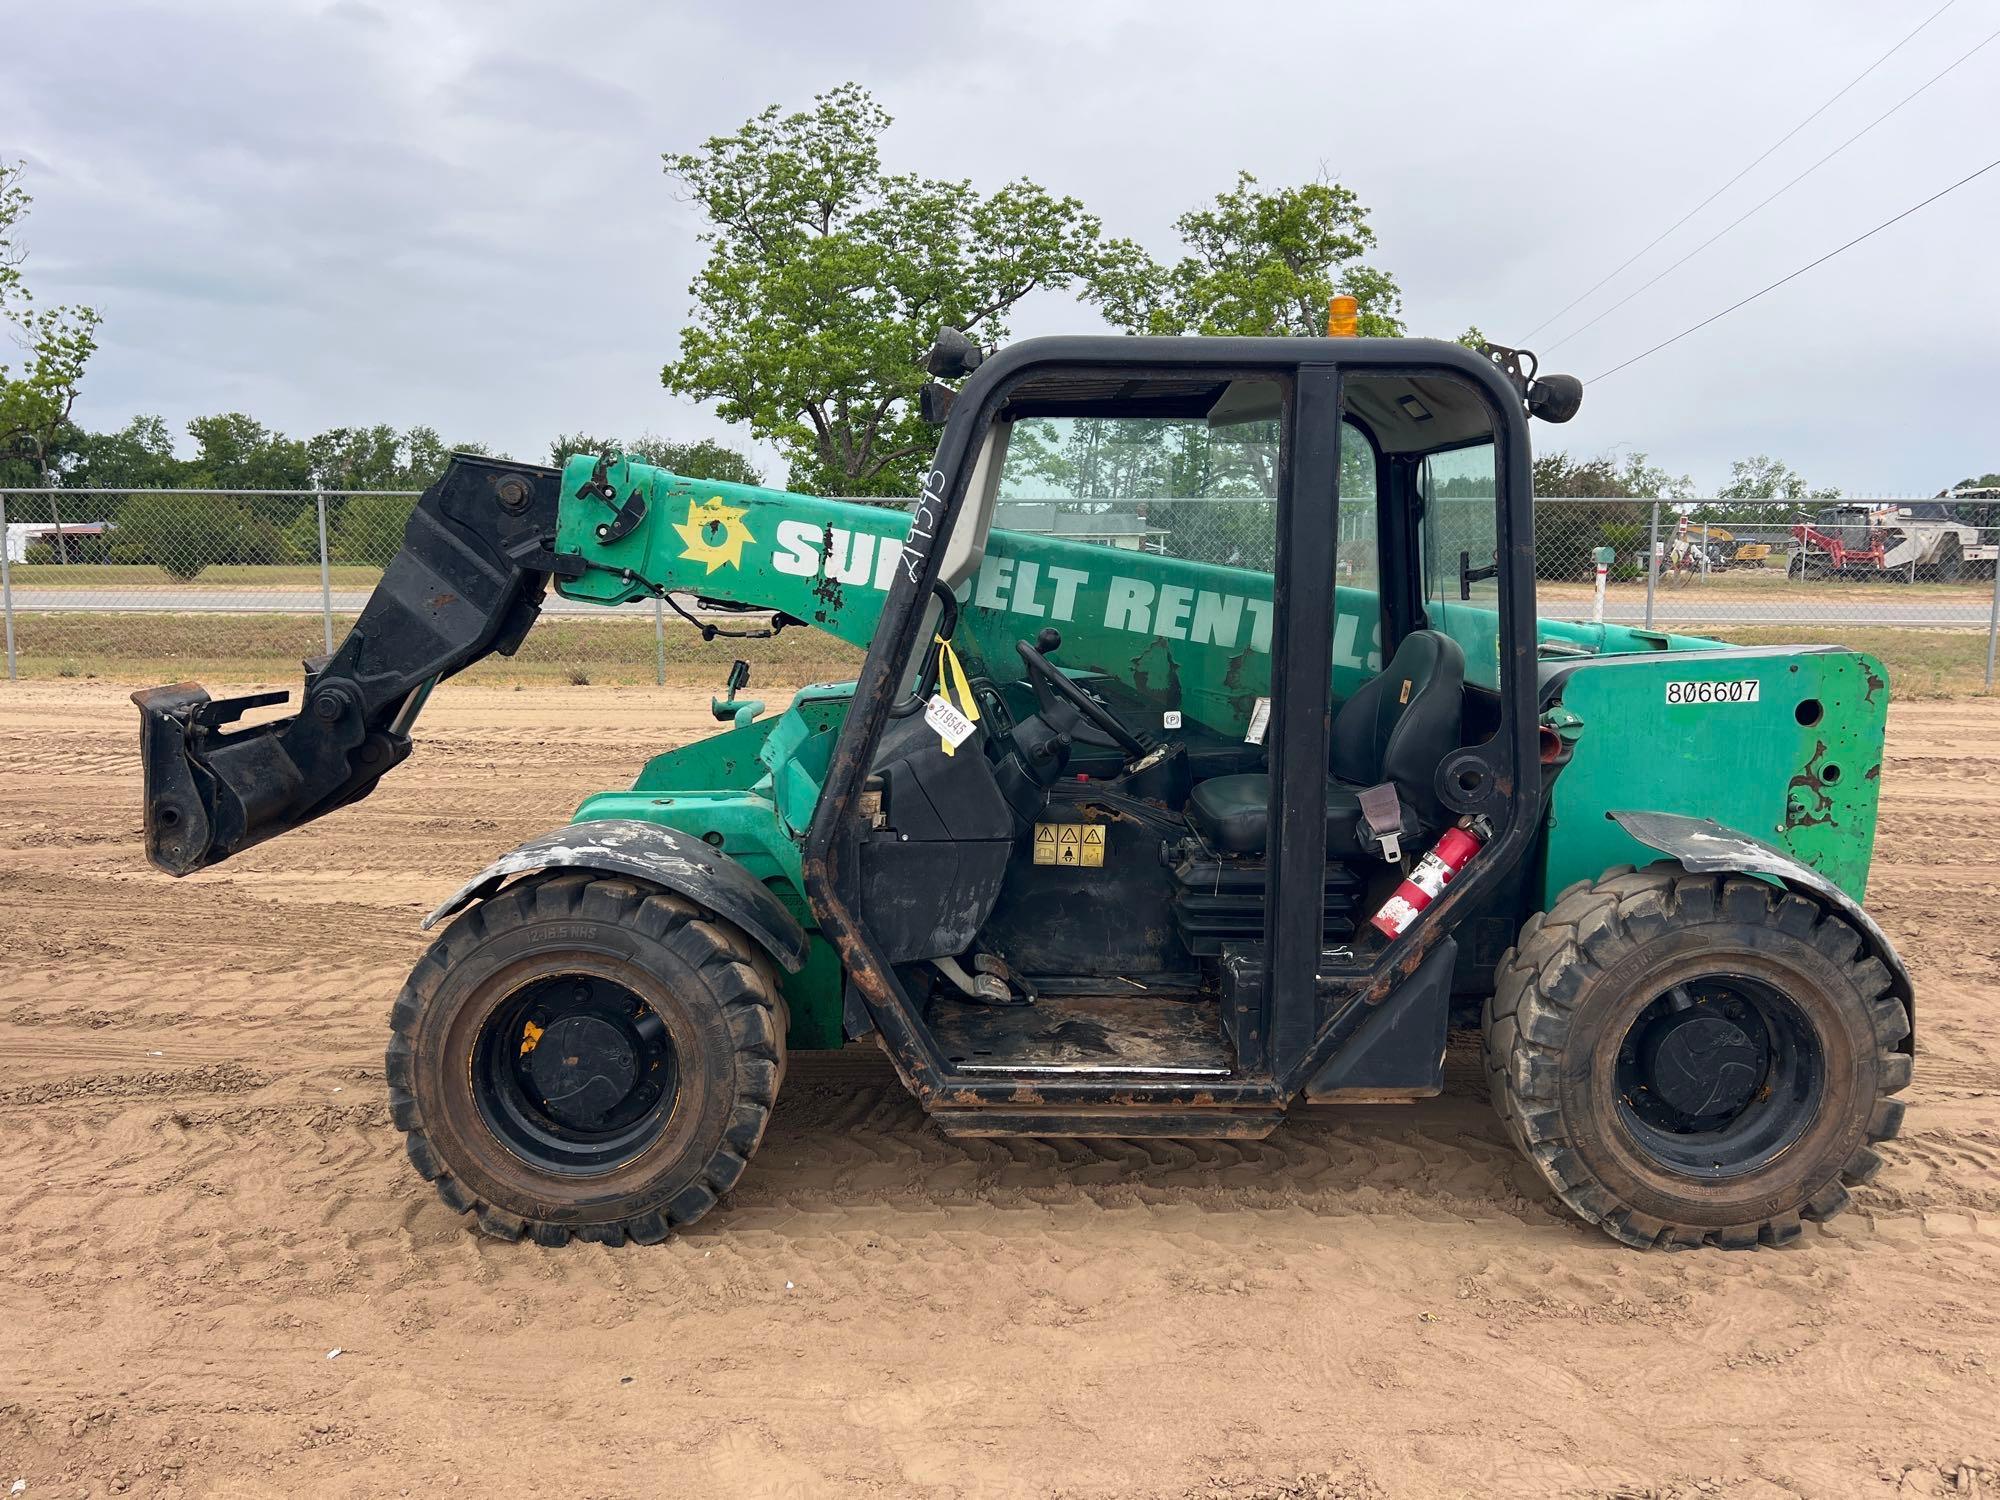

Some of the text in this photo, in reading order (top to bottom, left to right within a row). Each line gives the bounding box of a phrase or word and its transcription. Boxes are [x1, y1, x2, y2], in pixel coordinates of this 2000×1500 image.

[772, 519, 1382, 672] SUELT RENTL
[1668, 681, 1758, 703] 806607
[933, 703, 968, 737] 219545
[570, 925, 597, 940] NHS
